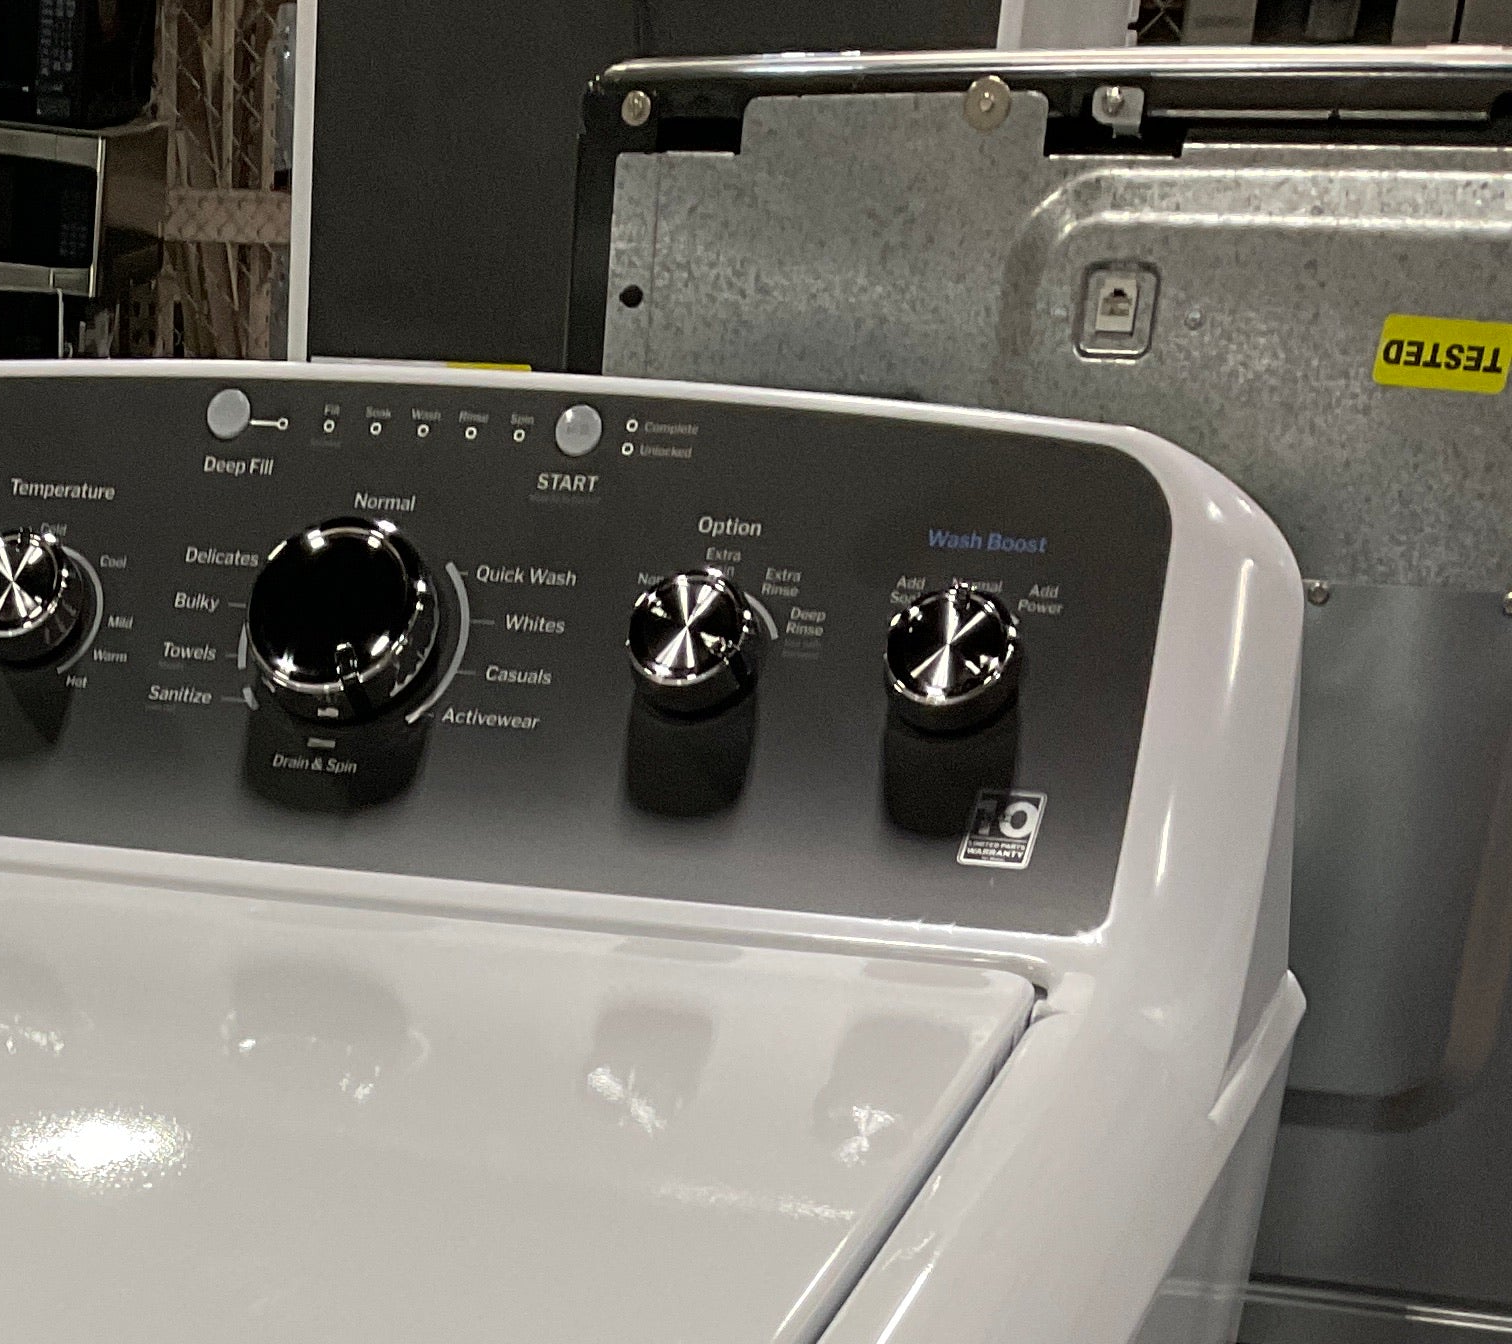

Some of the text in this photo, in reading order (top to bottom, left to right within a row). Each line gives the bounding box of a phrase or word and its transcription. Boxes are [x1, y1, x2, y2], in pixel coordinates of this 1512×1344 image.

[1383, 339, 1502, 374] TESTED
[204, 456, 273, 477] Deep Fill
[10, 477, 116, 501] Temperature
[537, 472, 600, 493] START
[354, 492, 416, 512] Normal
[698, 516, 763, 537] Option
[928, 529, 1048, 553] Wash Boost
[100, 554, 127, 569] Cool
[185, 546, 259, 568] Delicates
[705, 548, 742, 563] Extra
[476, 565, 577, 587] Quick Wash
[765, 567, 802, 583] Extra
[896, 574, 926, 591] Add
[761, 582, 800, 598] Rinse
[1028, 583, 1059, 599] Add
[174, 592, 220, 613] Bulky
[1018, 598, 1064, 616] Power
[108, 615, 134, 629] Mild
[790, 606, 826, 622] Deep
[505, 614, 566, 635] Whites
[786, 621, 824, 637] Rinse
[93, 649, 128, 663] Warm
[163, 641, 218, 662] Towels
[66, 675, 88, 688] Hot
[485, 664, 552, 685] Casuals
[148, 684, 213, 705] Sanitize
[442, 707, 541, 730] Activewear
[272, 754, 357, 774] Drain & Spin
